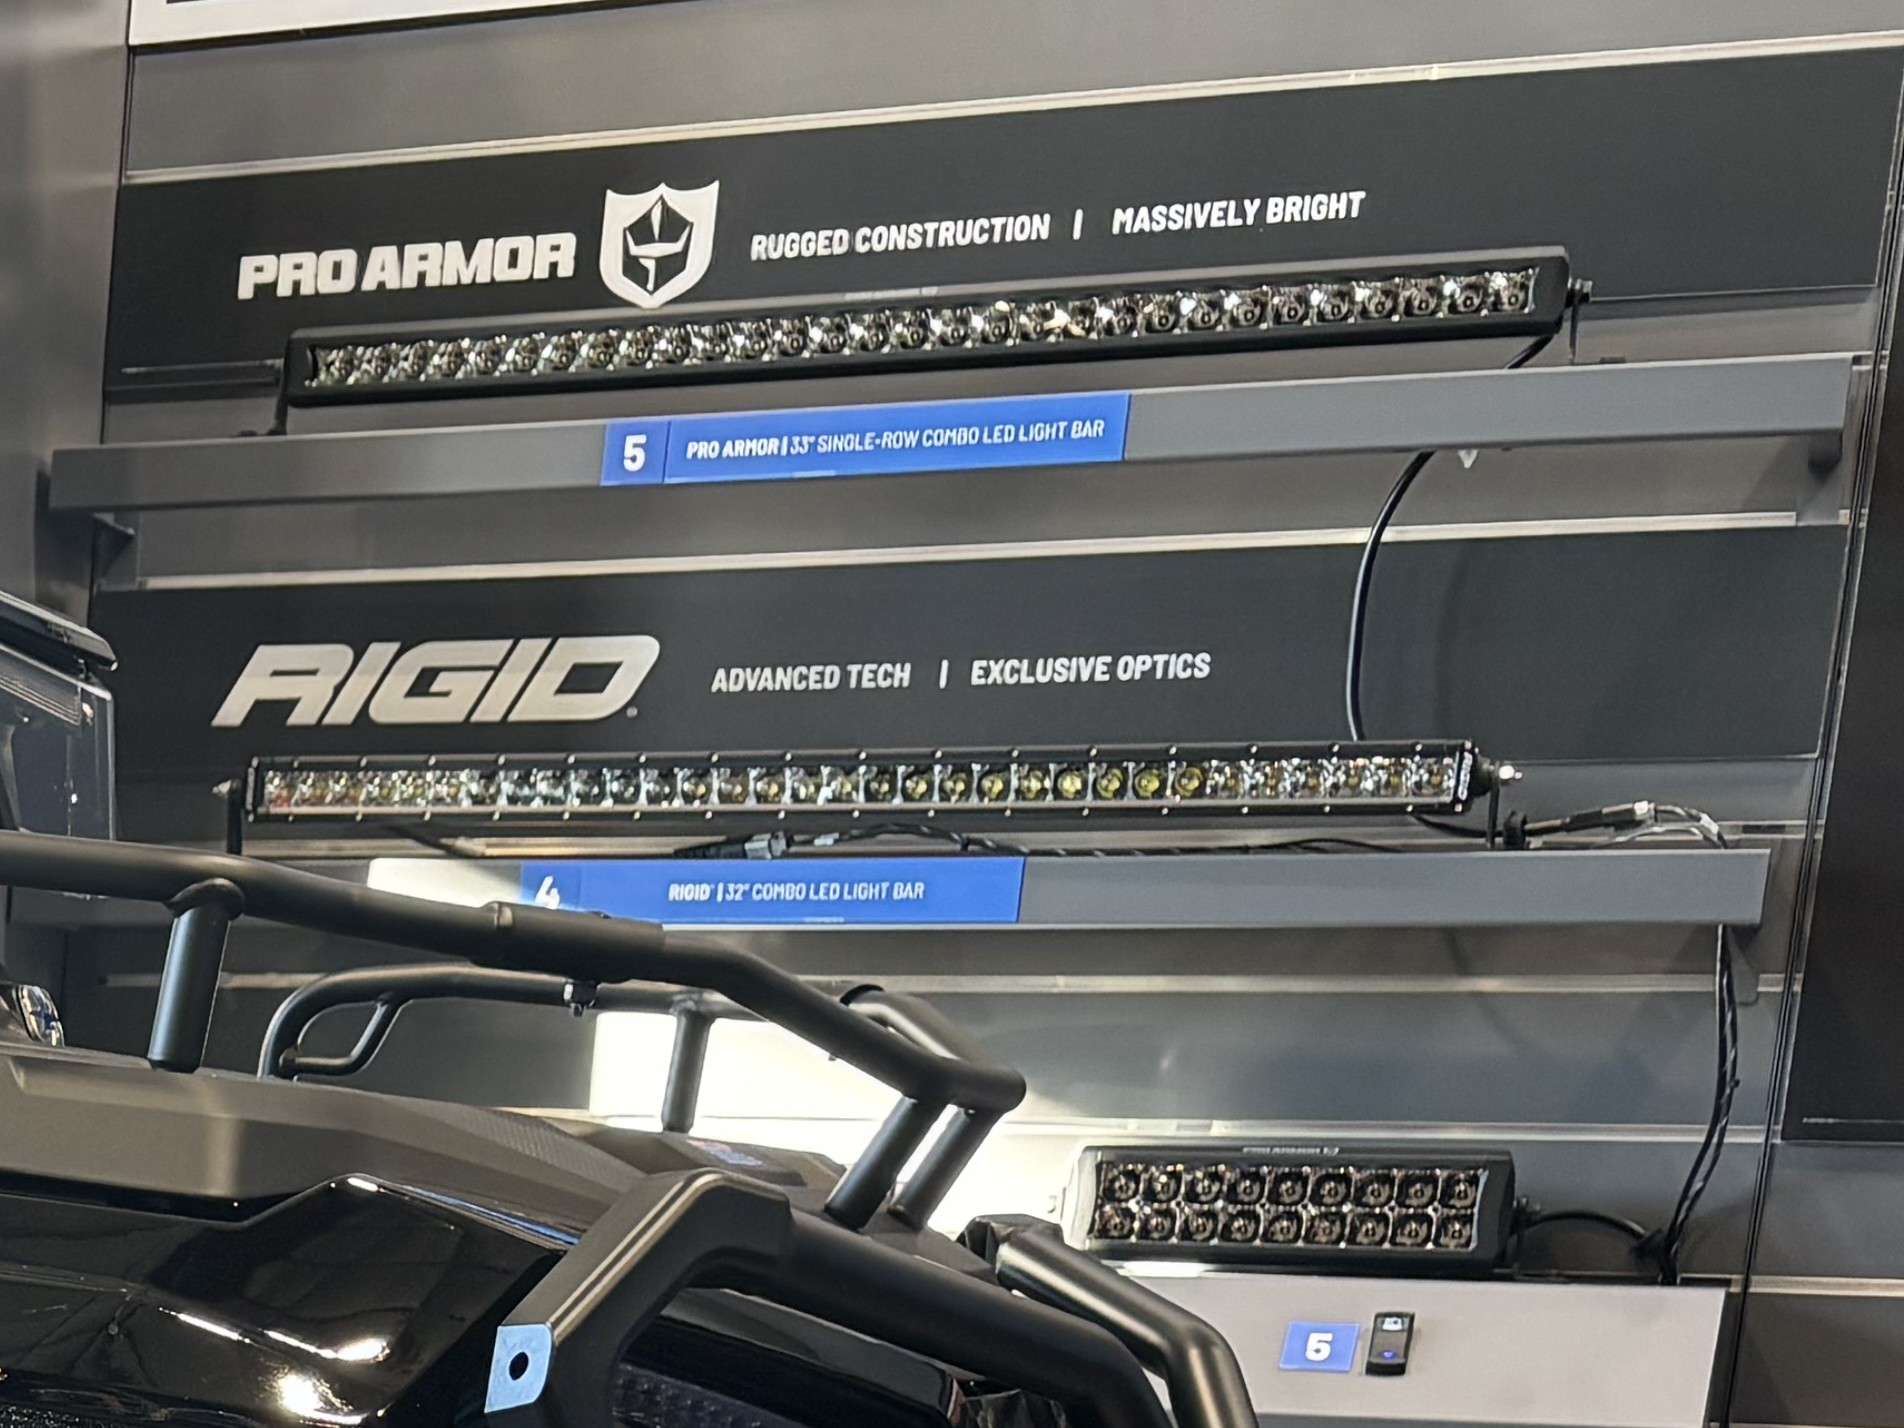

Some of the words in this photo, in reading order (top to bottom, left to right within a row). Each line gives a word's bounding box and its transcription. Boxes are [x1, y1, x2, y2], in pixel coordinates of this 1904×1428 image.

[750, 227, 849, 262] RUGGED
[853, 212, 1051, 255] CONSTRUCTION
[1111, 196, 1261, 236] MASSIVELY
[1265, 190, 1367, 225] BRIGHT
[238, 248, 357, 299] PRO
[360, 232, 577, 292] ARMOR
[622, 434, 647, 472] 5
[686, 440, 720, 460] PRO
[721, 437, 780, 459] ARMOR
[817, 430, 920, 454] SINGLE-ROW
[922, 426, 979, 449] COMBO
[982, 424, 1015, 446] LED
[1017, 420, 1068, 444] LIGHT
[1070, 419, 1106, 441] BAR
[210, 635, 661, 727] RIGID
[710, 663, 841, 694] ADVANCED
[846, 661, 911, 691] TECH
[970, 655, 1111, 687] EXCLUSIVE
[1116, 651, 1211, 682] OPTICS
[534, 875, 562, 911] 4
[751, 882, 807, 902] COMBO
[809, 882, 841, 902] LED
[843, 881, 890, 902] LIGHT
[892, 881, 925, 901] BAR
[1304, 1332, 1334, 1362] 5
